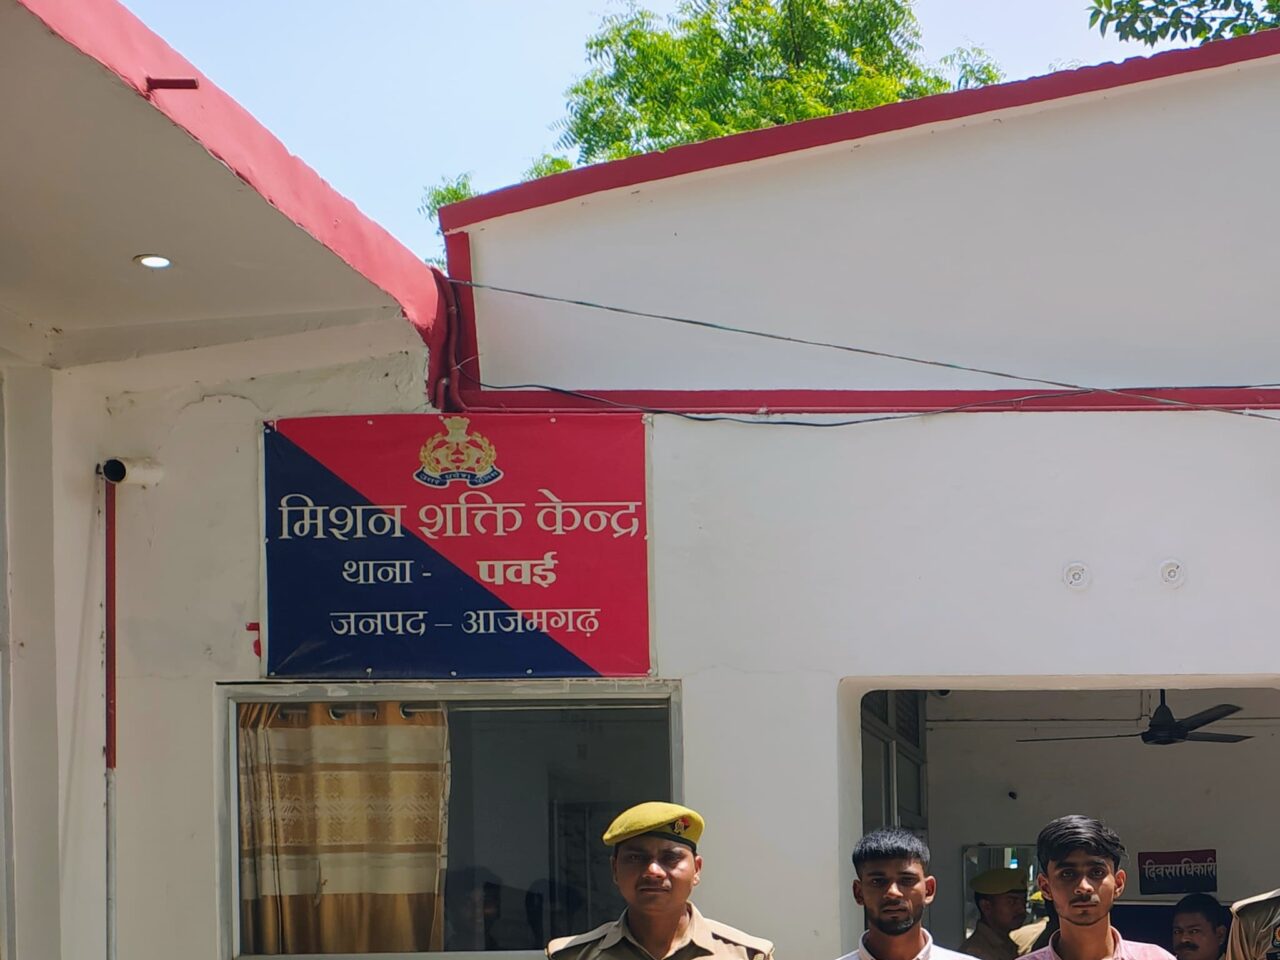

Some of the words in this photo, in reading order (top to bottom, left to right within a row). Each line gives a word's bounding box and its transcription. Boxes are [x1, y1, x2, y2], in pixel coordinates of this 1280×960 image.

[278, 494, 407, 541] मिशन
[417, 490, 526, 539] शक्ति
[534, 488, 642, 539] केन्द्र
[342, 559, 414, 584] थाना
[476, 551, 559, 588] पवई
[330, 610, 428, 636] जनपद
[460, 607, 601, 638] आजमगढ़
[1142, 856, 1217, 881] दिवसाधिकारी
